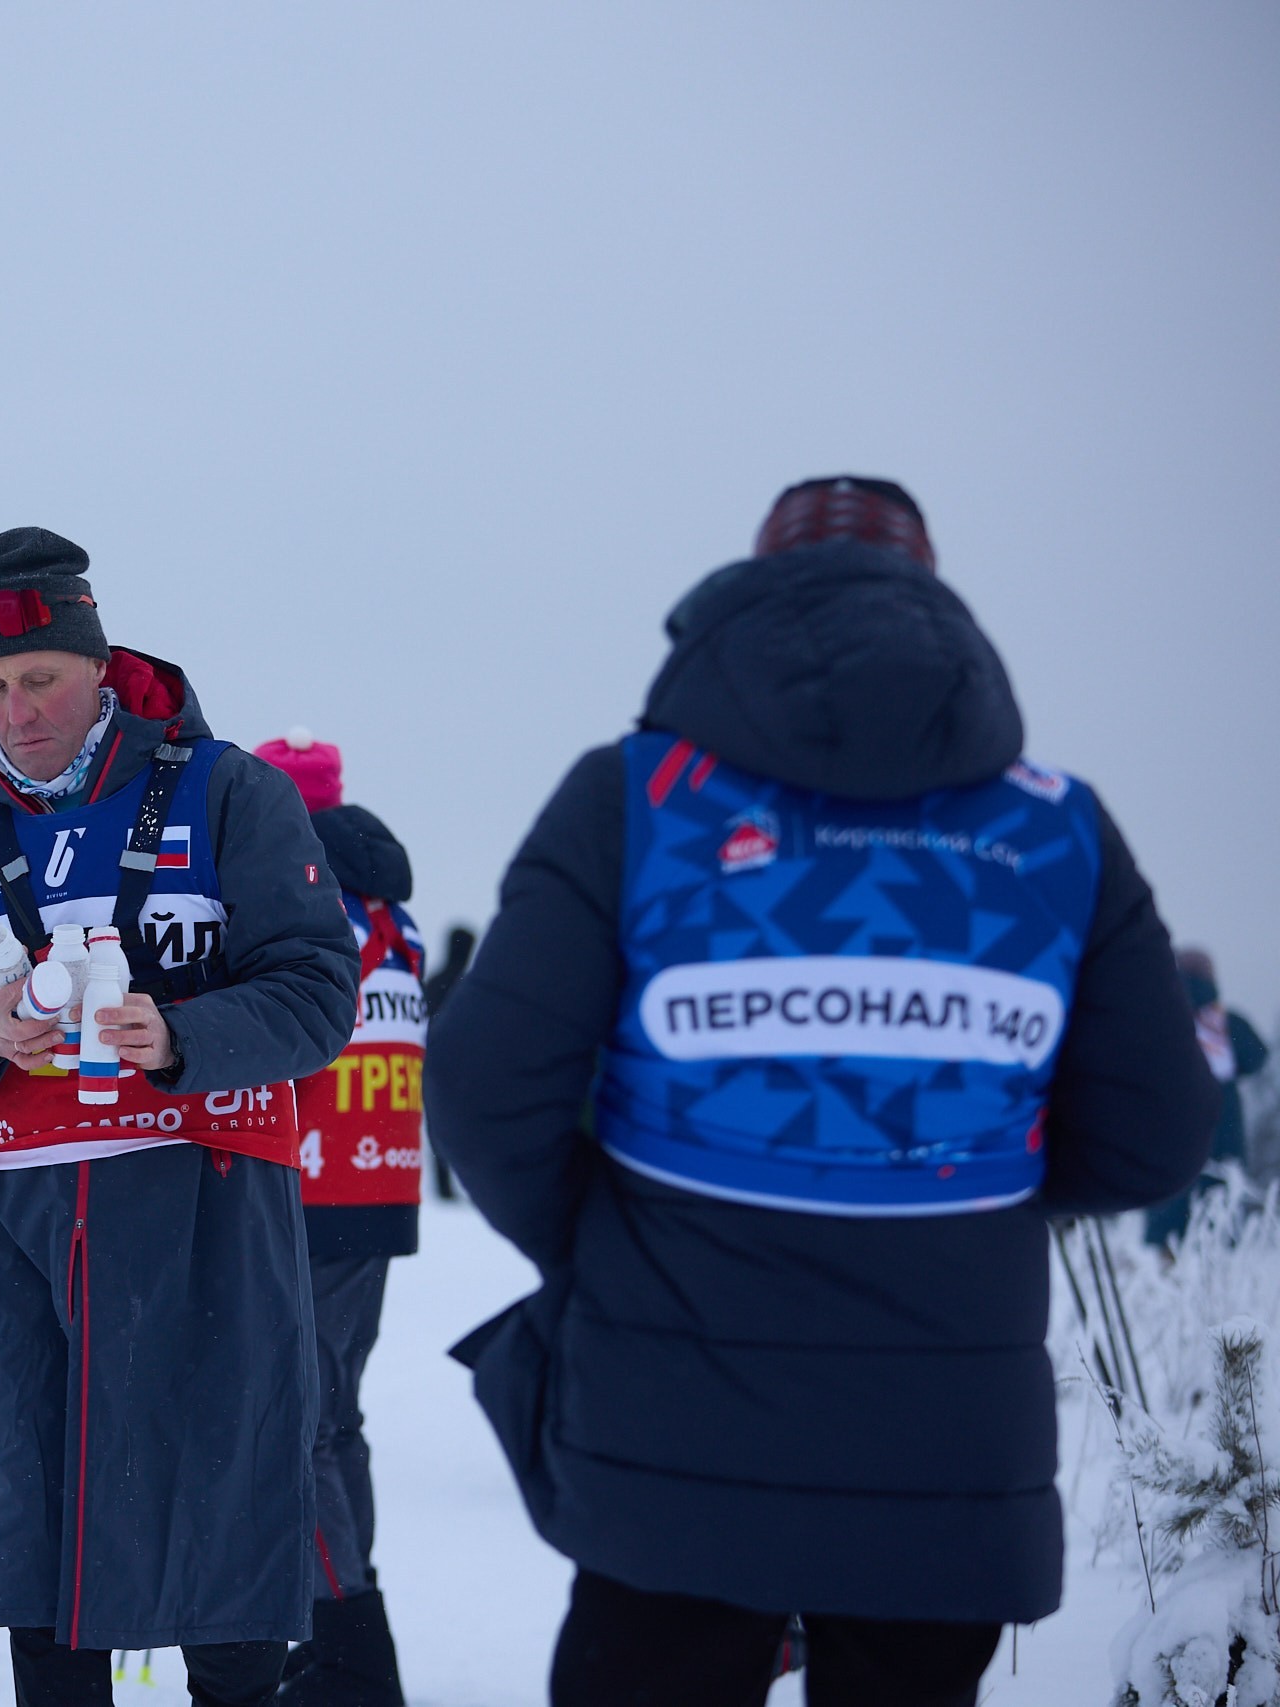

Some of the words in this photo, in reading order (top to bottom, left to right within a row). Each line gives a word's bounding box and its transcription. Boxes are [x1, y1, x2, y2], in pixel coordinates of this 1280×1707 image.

[666, 986, 970, 1035] ПЕРСОНАЛ
[986, 1000, 1047, 1049] 140
[211, 1116, 277, 1131] GROUP
